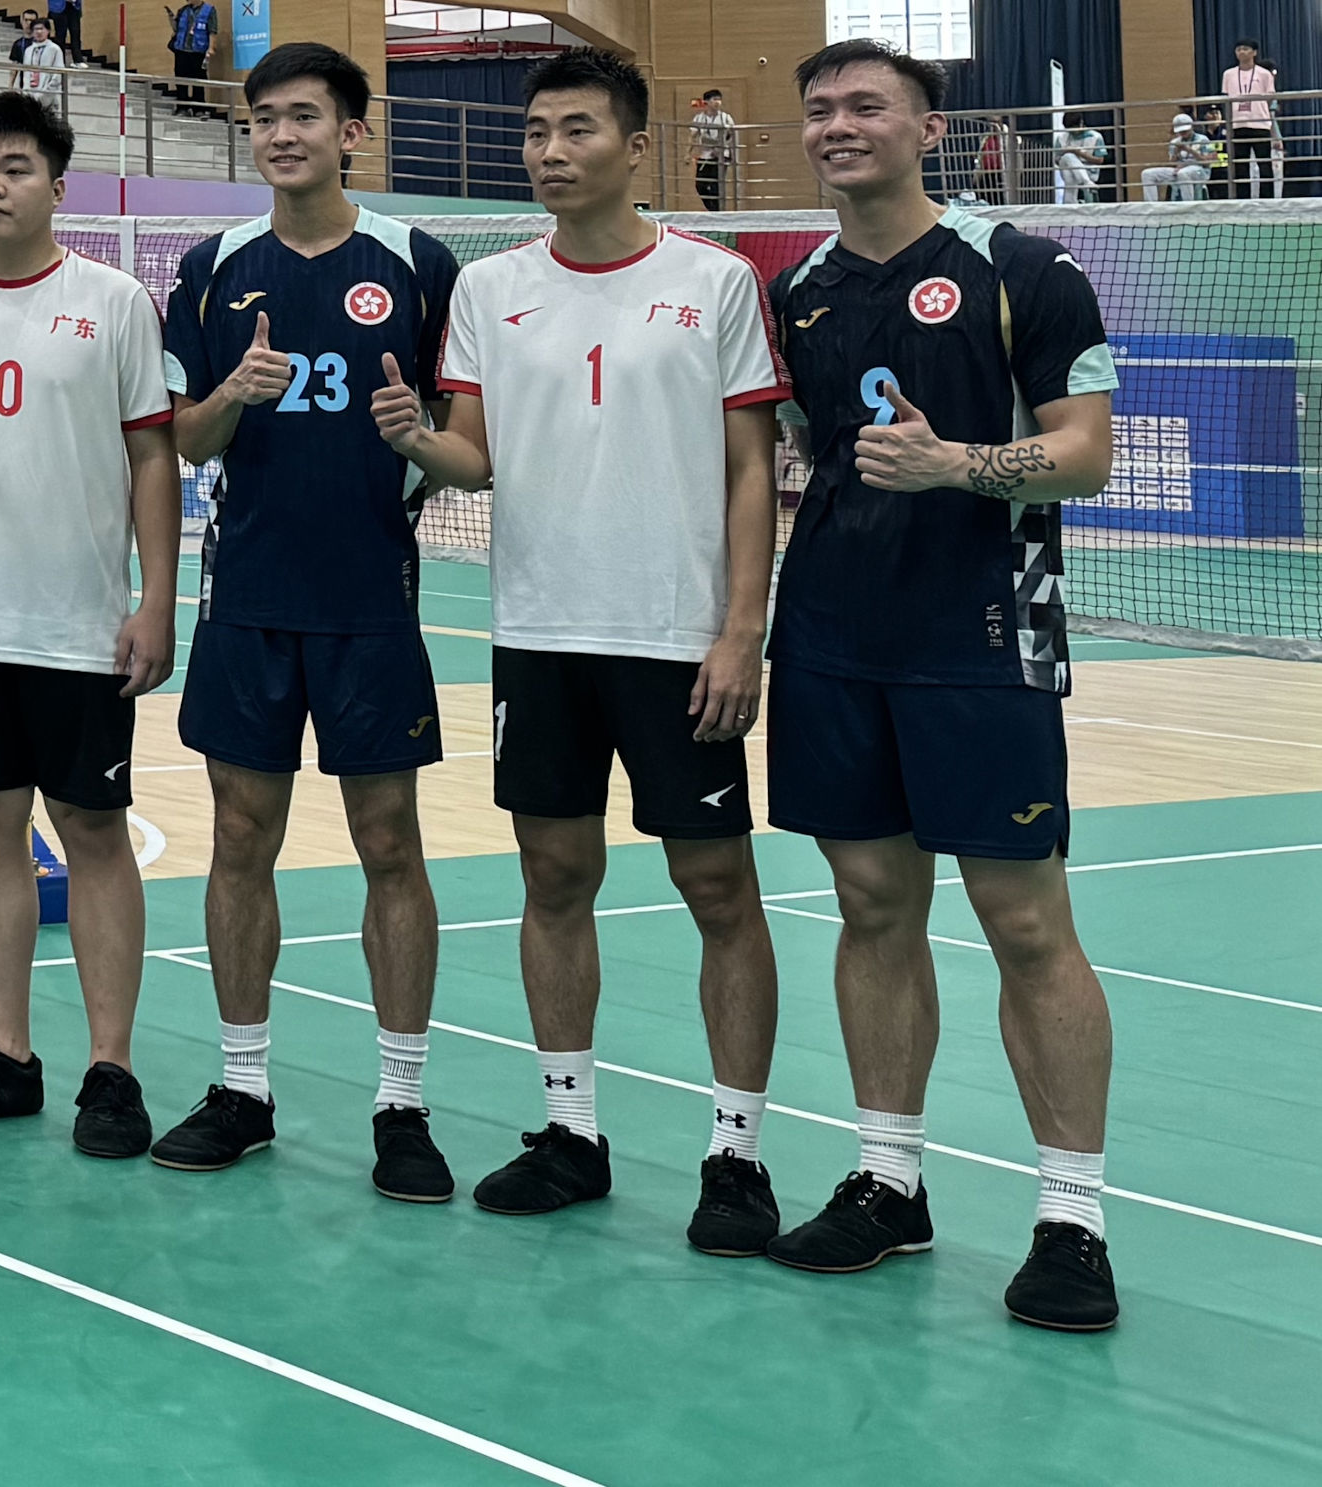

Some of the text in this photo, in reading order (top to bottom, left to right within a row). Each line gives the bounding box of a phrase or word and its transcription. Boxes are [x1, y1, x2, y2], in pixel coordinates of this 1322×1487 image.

[50, 314, 97, 340] 广东
[646, 302, 702, 328] 广东
[275, 352, 350, 412] 23
[587, 344, 602, 405] 1
[860, 367, 901, 426] 9
[494, 700, 508, 762] 1
